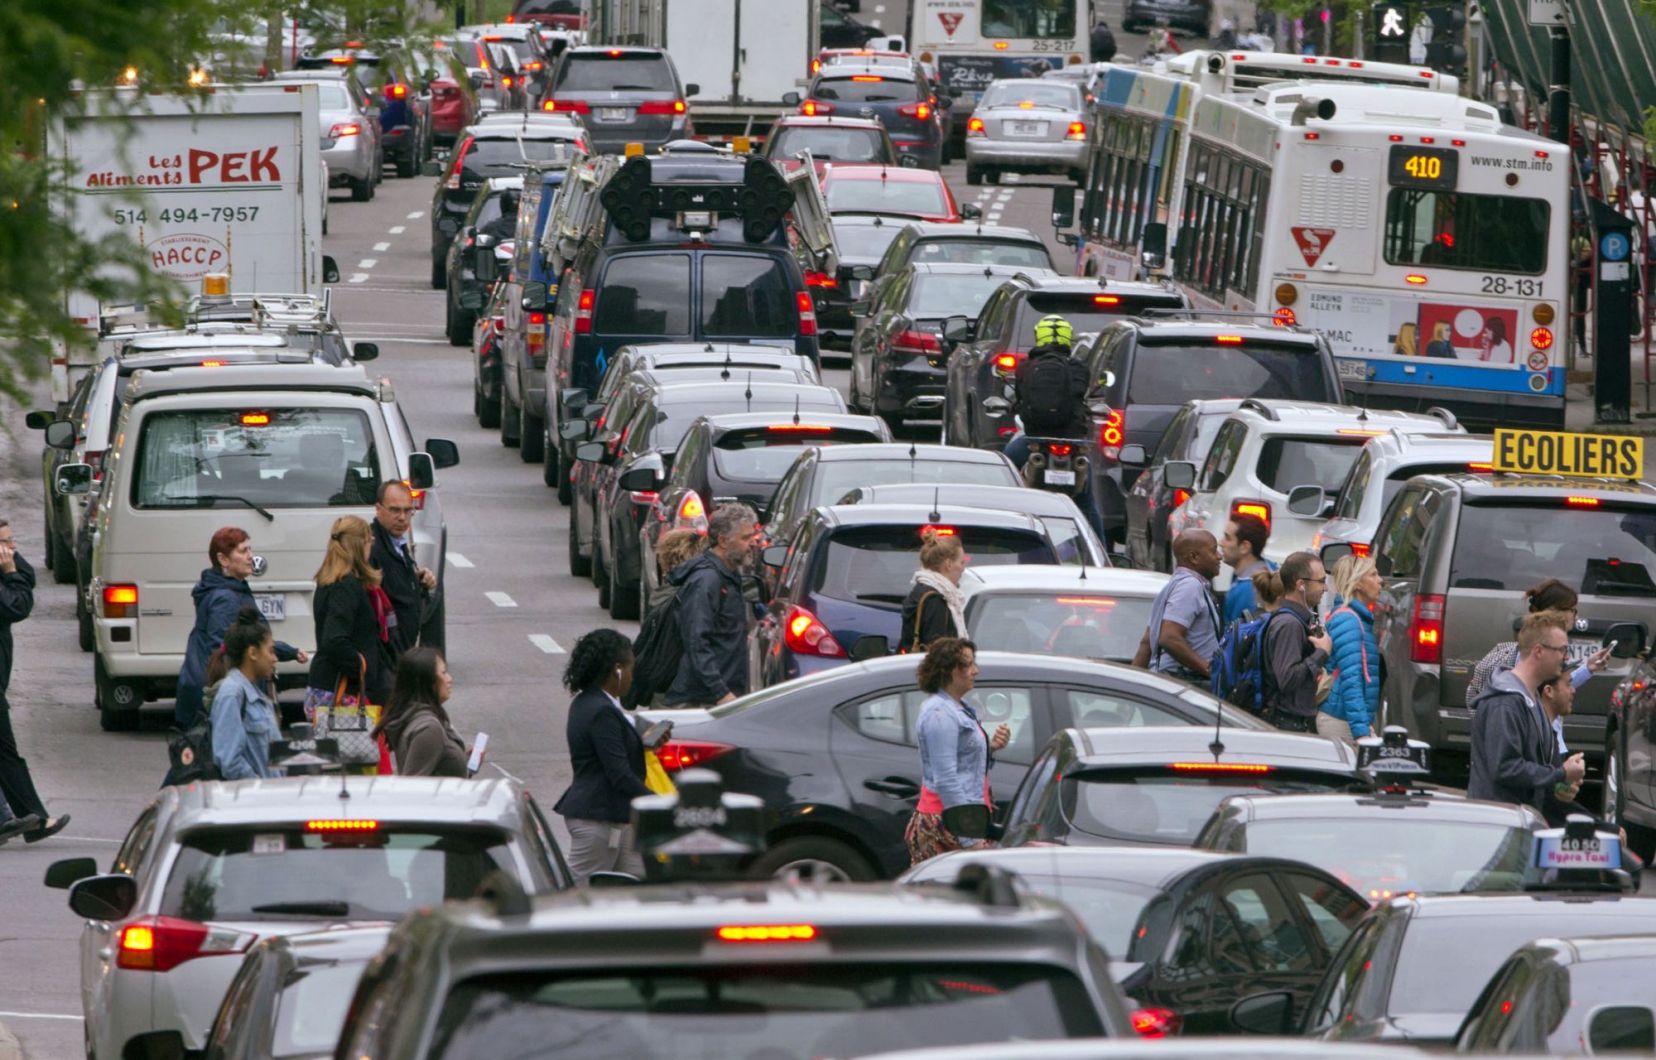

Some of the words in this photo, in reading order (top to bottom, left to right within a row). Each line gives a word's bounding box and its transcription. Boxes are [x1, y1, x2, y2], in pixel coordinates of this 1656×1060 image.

[1033, 40, 1076, 50] 25-217
[149, 154, 182, 169] Les
[188, 146, 281, 184] PEK
[1405, 156, 1441, 178] 410
[1471, 155, 1553, 171] www.stm.info
[86, 171, 182, 187] Aliments
[114, 209, 148, 225] 514
[159, 206, 260, 223] 494-7957
[152, 246, 222, 268] HACCP
[1481, 276, 1544, 297] 28-131
[1311, 294, 1342, 303] EDMUND
[1310, 303, 1342, 311] ALLEYN
[1327, 330, 1353, 342] MAC
[1500, 432, 1637, 476] ECOLIERS
[262, 599, 284, 614] GYN
